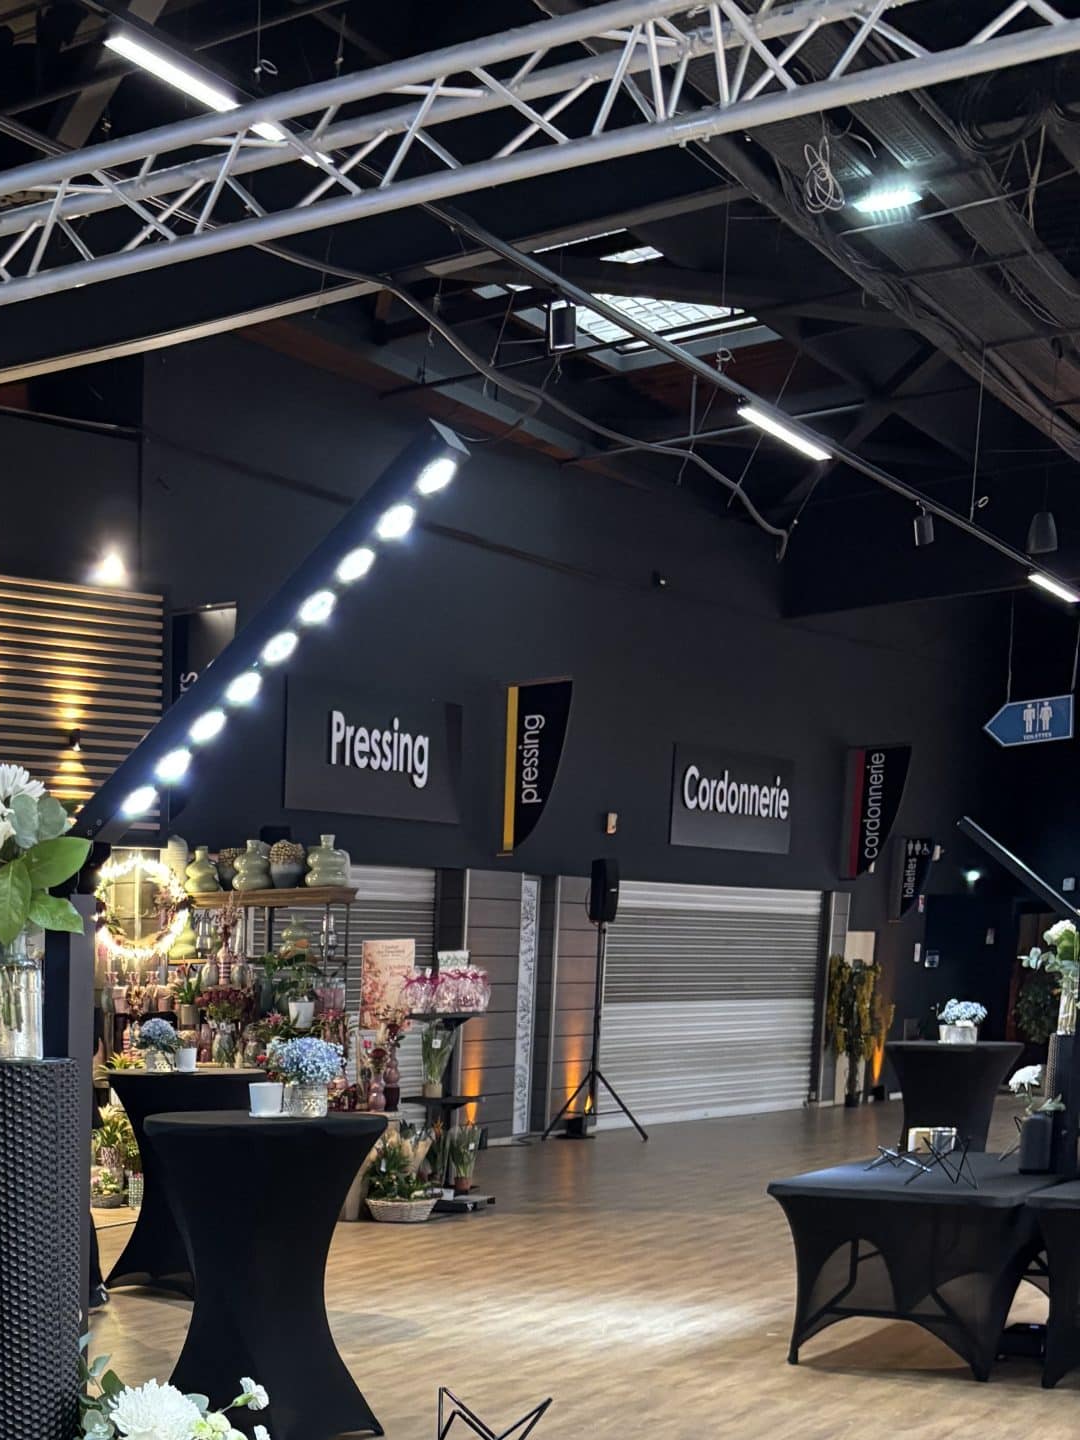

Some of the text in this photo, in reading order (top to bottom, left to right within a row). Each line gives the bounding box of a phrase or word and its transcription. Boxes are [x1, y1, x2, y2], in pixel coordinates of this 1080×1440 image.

[331, 710, 429, 788] Pressing
[519, 714, 545, 804] pressing
[683, 765, 790, 820] Cordonnerie
[863, 752, 886, 860] cordonnerie
[903, 857, 918, 898] toilettes
